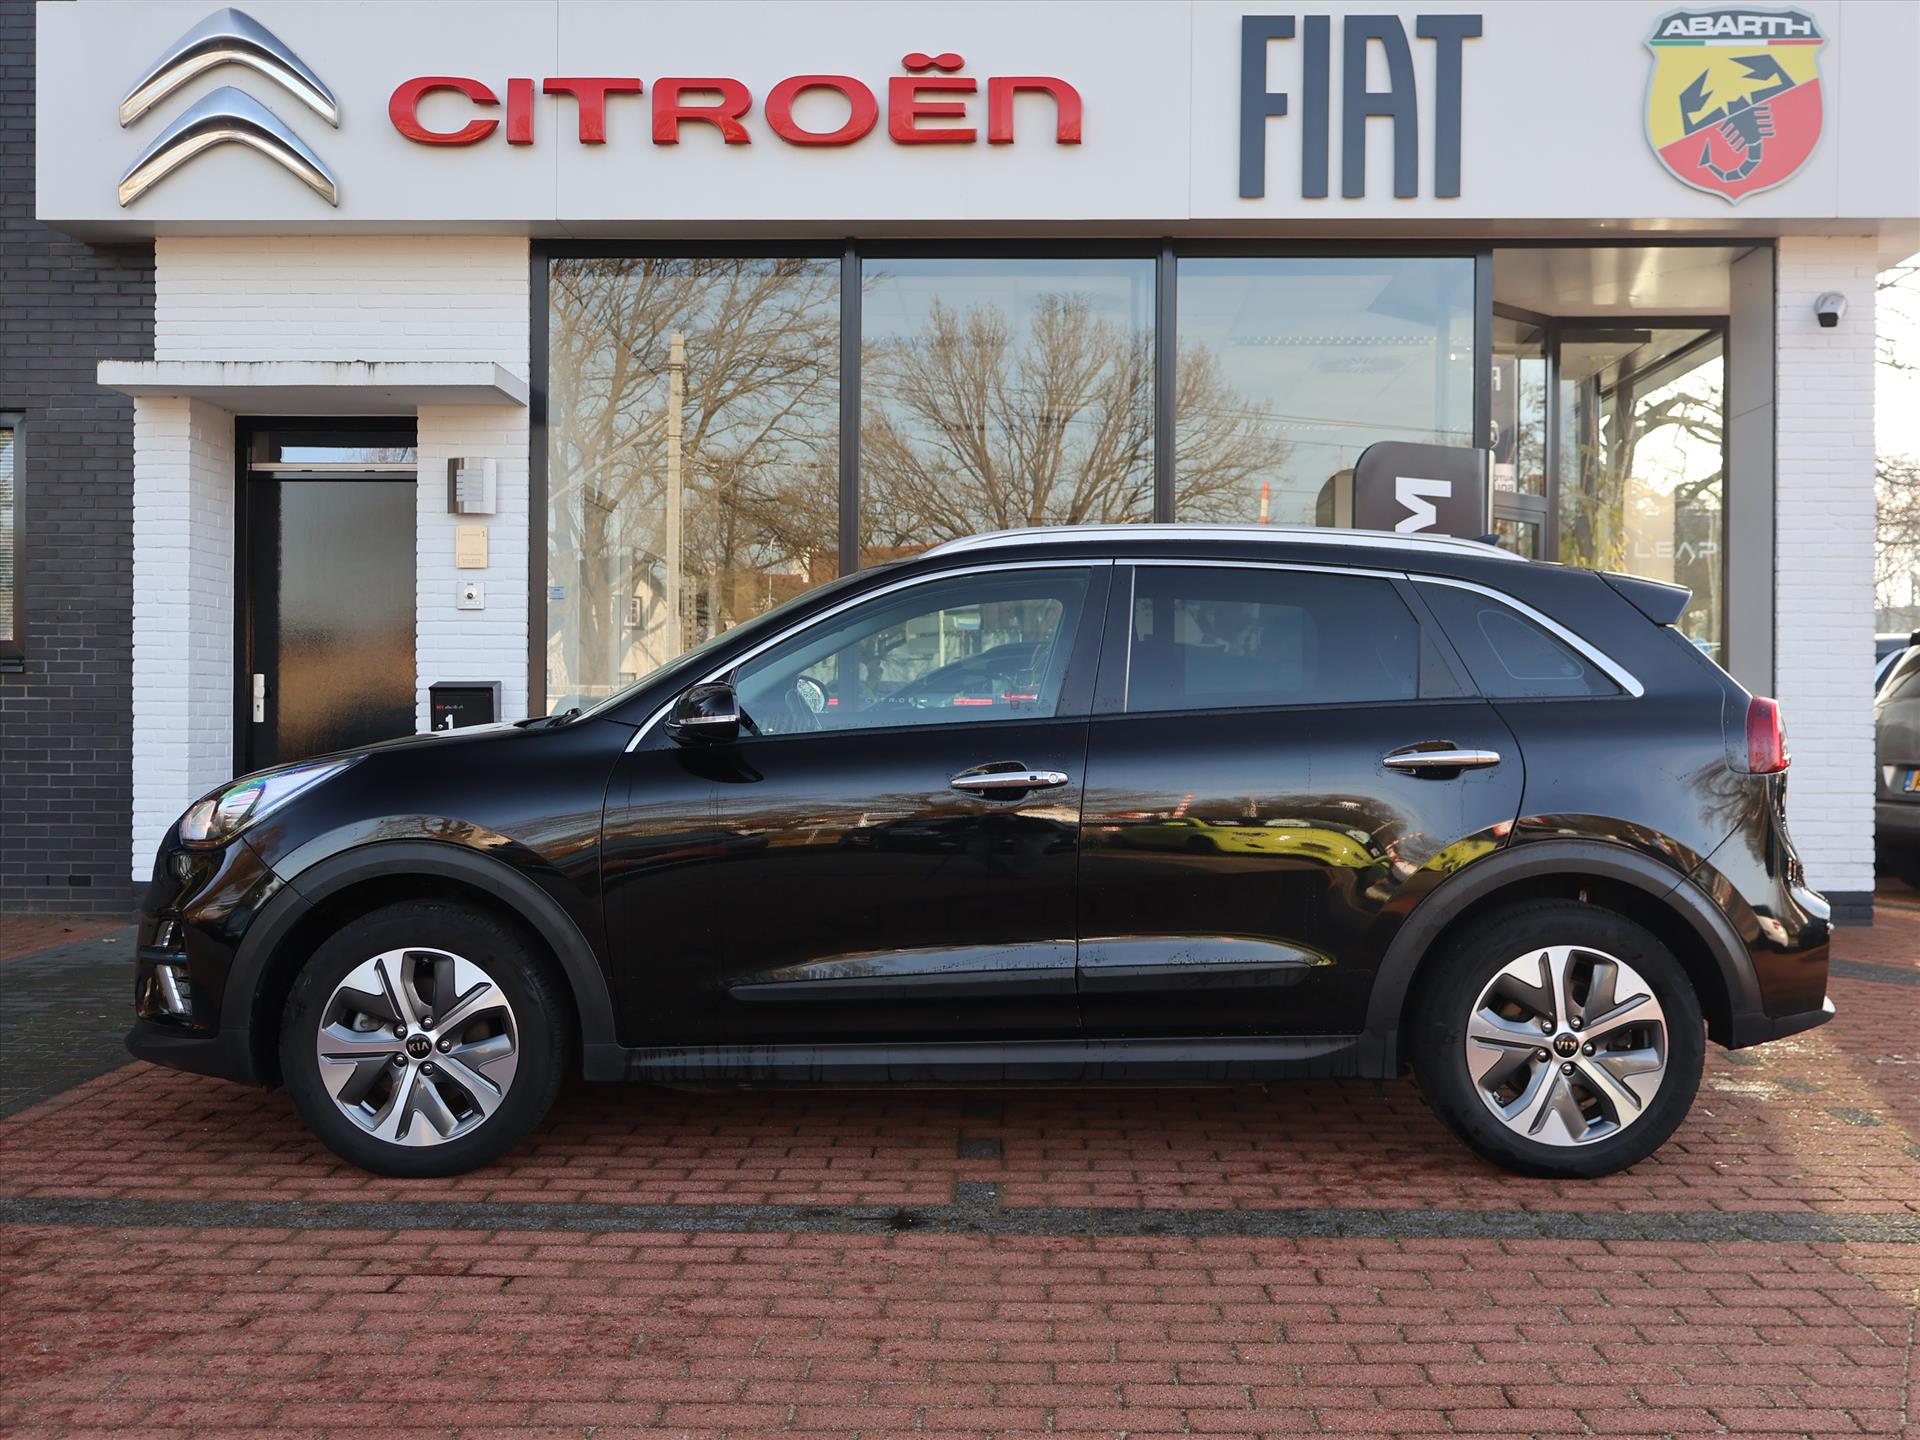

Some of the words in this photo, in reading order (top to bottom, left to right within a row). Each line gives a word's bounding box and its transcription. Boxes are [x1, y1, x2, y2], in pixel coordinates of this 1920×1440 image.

[1662, 15, 1811, 36] ABARTH
[388, 52, 1082, 146] CITROËN
[1239, 14, 1482, 198] FIAT
[445, 714, 454, 730] 1
[408, 1041, 430, 1051] KIA
[1556, 1040, 1577, 1050] KIA
